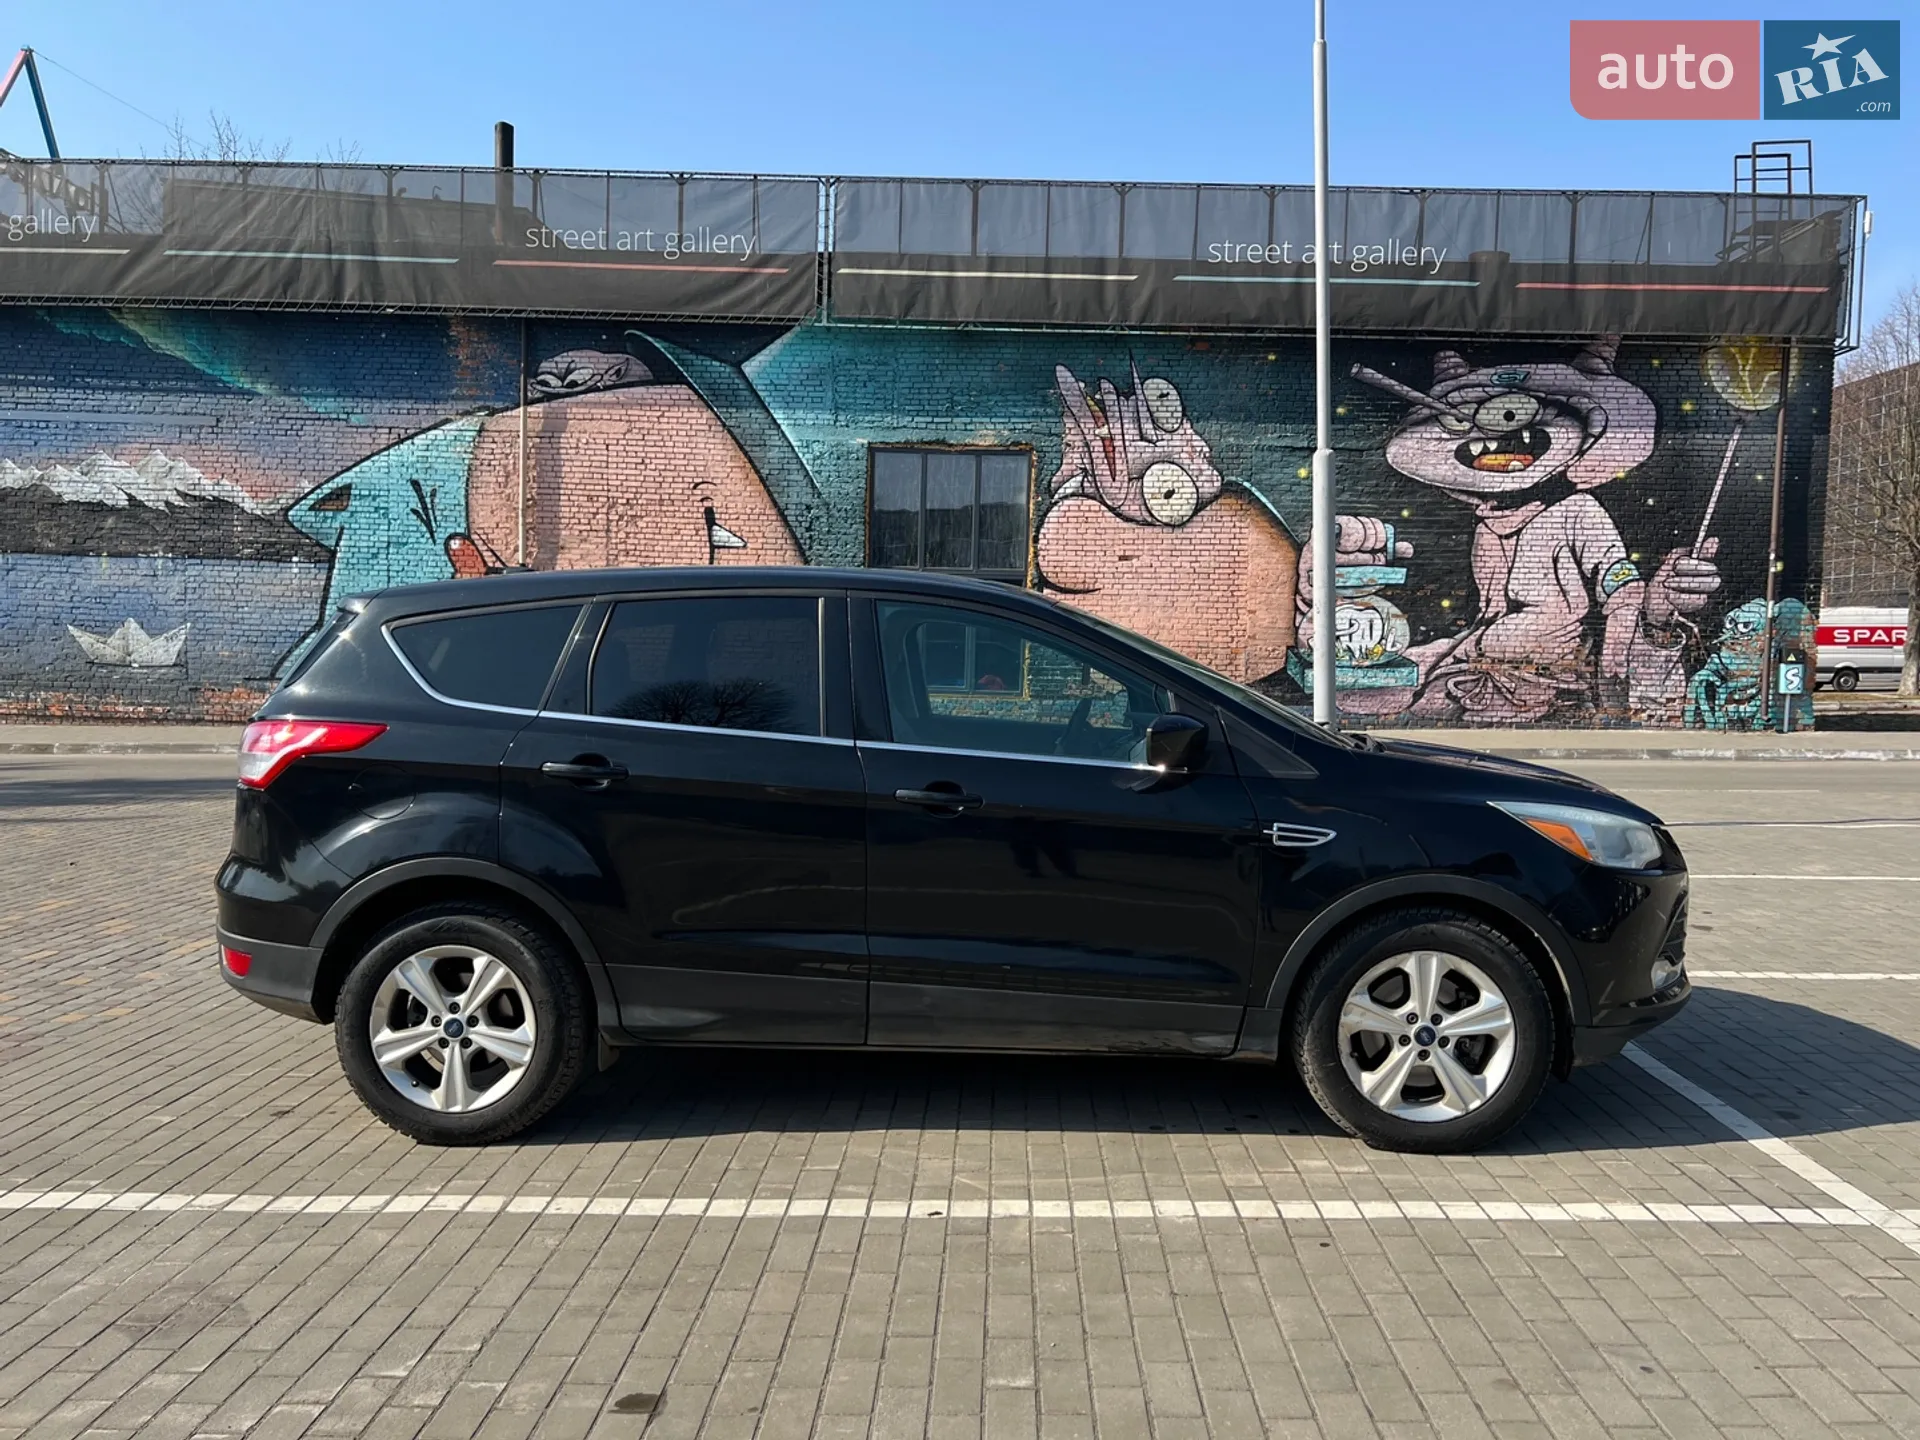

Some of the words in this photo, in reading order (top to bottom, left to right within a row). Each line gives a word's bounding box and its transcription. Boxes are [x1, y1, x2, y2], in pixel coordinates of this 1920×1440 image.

[8, 208, 97, 243] gallery
[525, 225, 607, 251] street
[616, 228, 655, 252] art
[663, 226, 757, 262] gallery
[1207, 239, 1292, 264] street
[1301, 241, 1342, 265] at
[1350, 238, 1447, 275] gallery
[1833, 629, 1908, 643] SPAR
